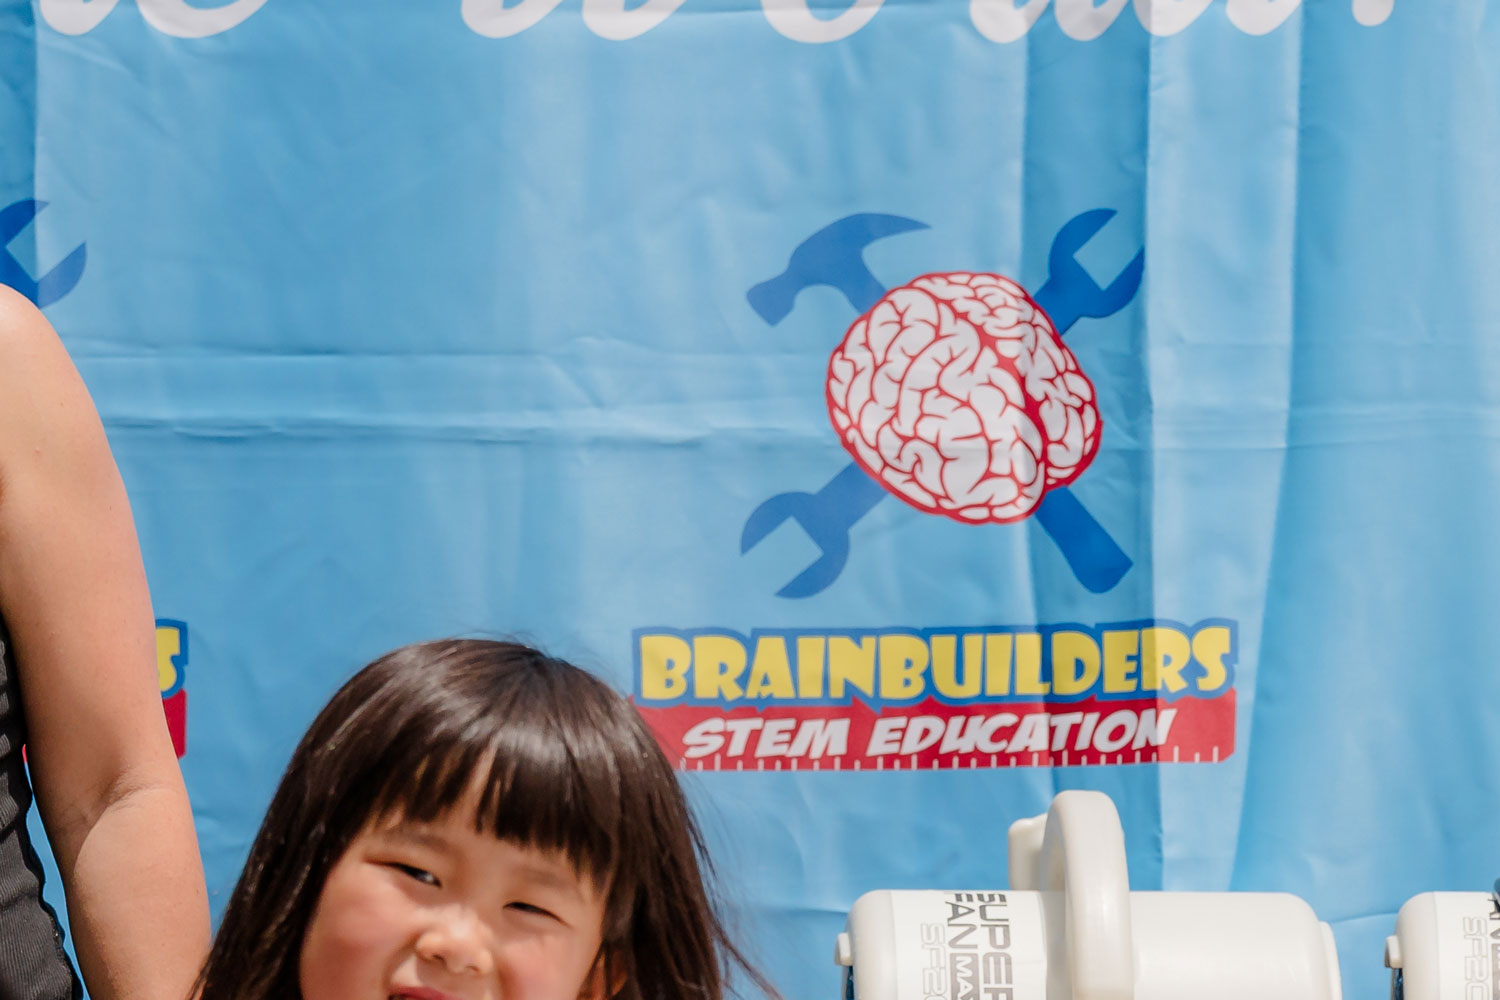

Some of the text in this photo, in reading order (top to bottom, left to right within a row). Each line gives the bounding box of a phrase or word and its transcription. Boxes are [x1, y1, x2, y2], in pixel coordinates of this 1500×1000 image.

[638, 626, 1232, 702] BRAINBUILDERS
[682, 708, 1177, 760] STEM EDUCATION
